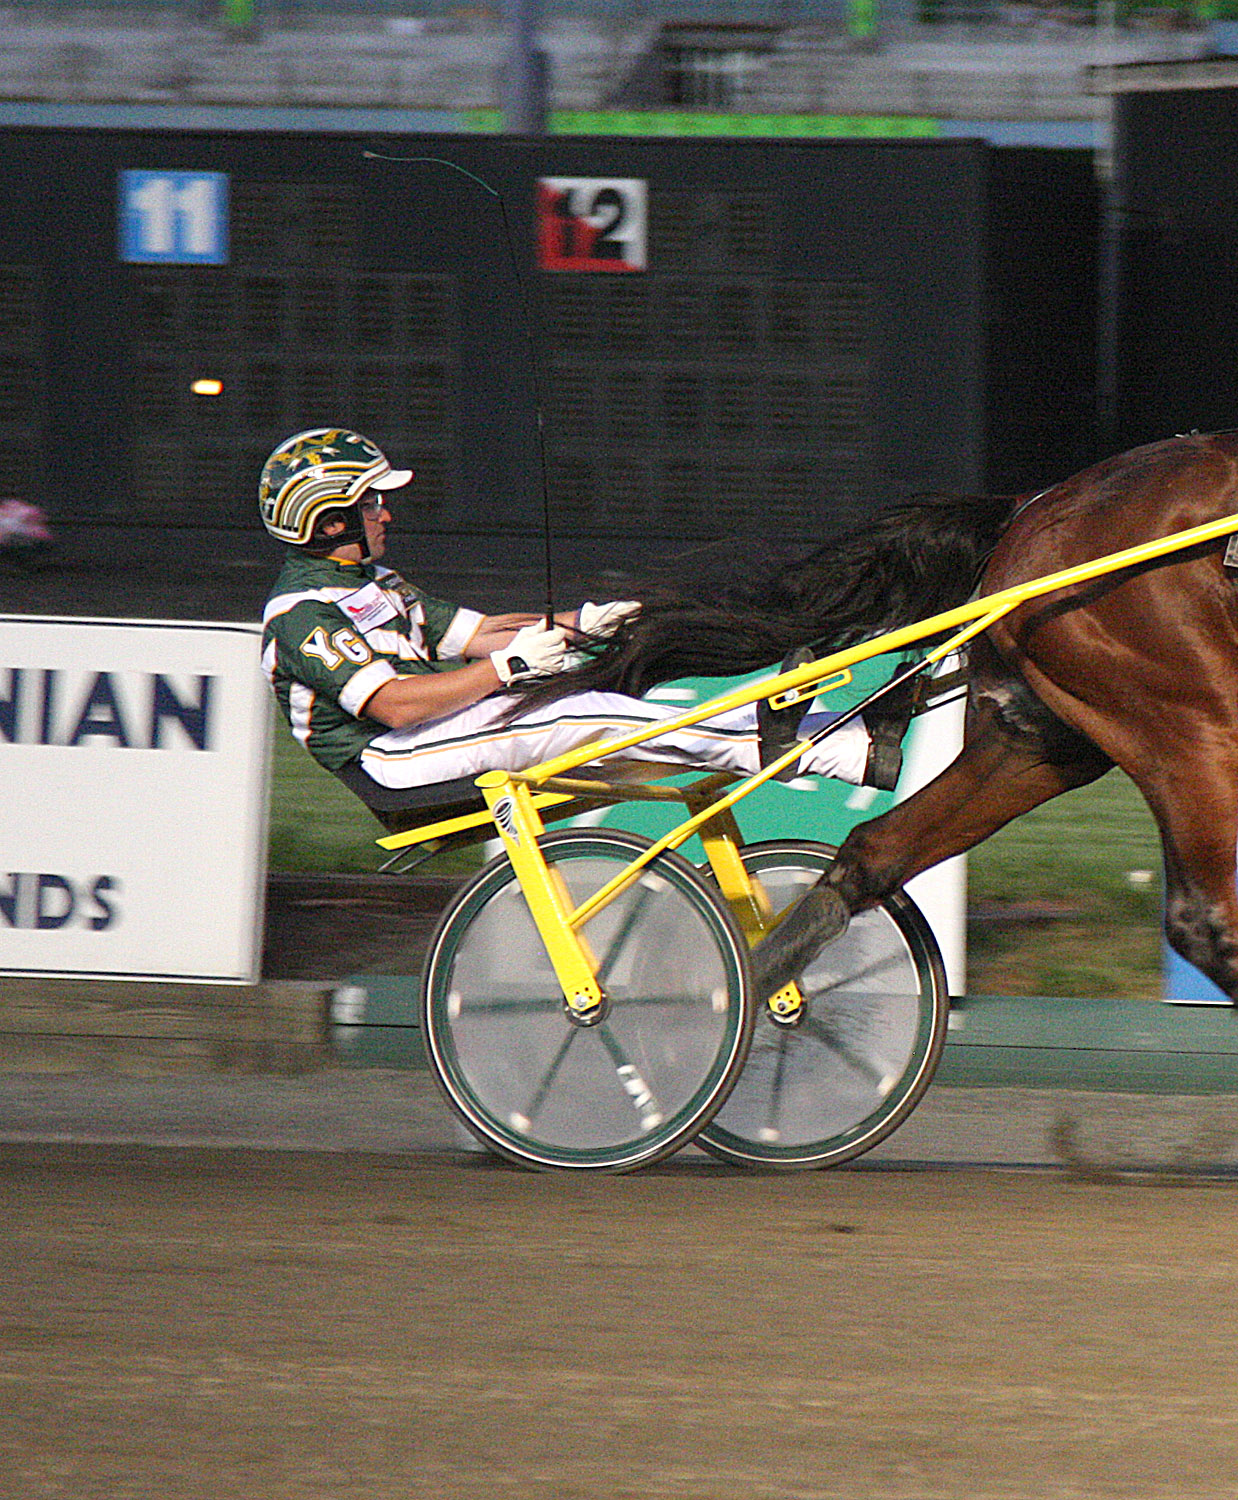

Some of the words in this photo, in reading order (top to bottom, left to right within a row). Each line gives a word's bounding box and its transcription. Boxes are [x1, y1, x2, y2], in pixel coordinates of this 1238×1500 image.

[127, 178, 217, 252] 11
[552, 187, 625, 259] 12
[300, 626, 373, 671] YG
